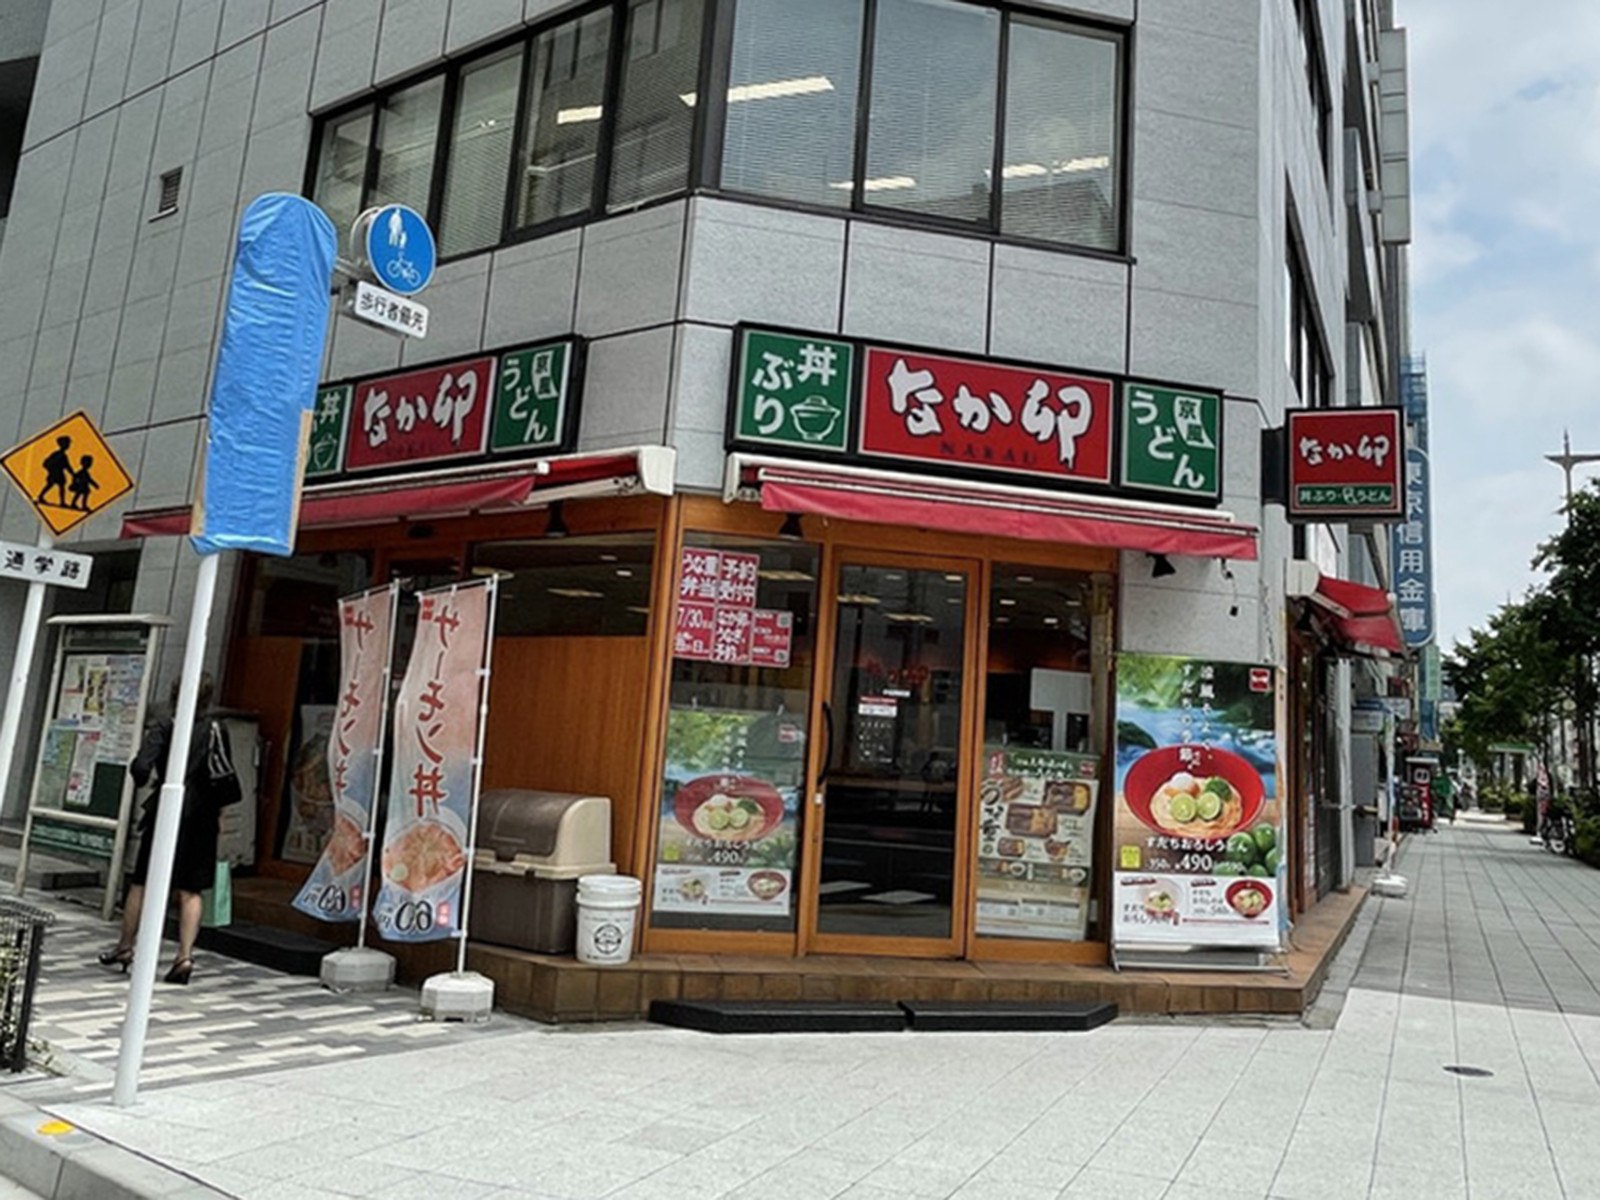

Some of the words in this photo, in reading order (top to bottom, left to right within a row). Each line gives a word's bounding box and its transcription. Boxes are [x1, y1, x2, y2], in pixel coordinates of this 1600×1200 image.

[360, 292, 423, 331] 歩行者優先
[363, 370, 479, 448] なか卯
[502, 358, 549, 443] うどん
[887, 358, 1096, 470] なか卯
[1129, 391, 1205, 490] うどん
[1299, 434, 1390, 467] なか卯
[4, 550, 81, 580] 通学路
